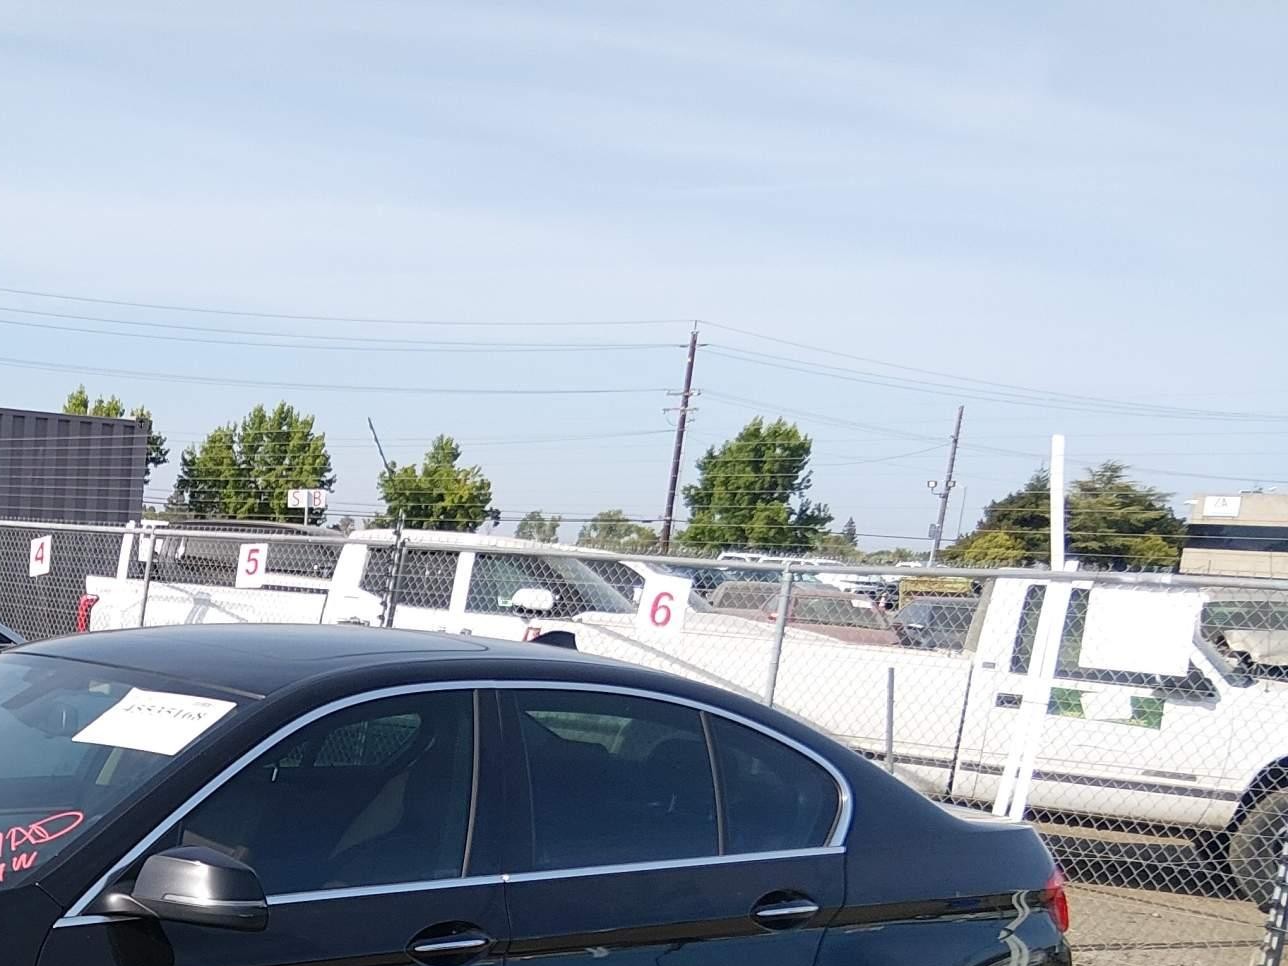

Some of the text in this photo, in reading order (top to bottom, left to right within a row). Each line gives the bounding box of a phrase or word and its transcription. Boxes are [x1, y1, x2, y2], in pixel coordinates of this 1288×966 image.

[291, 489, 322, 507] S B
[34, 541, 45, 565] 4
[244, 548, 261, 576] 5
[650, 591, 675, 628] 6
